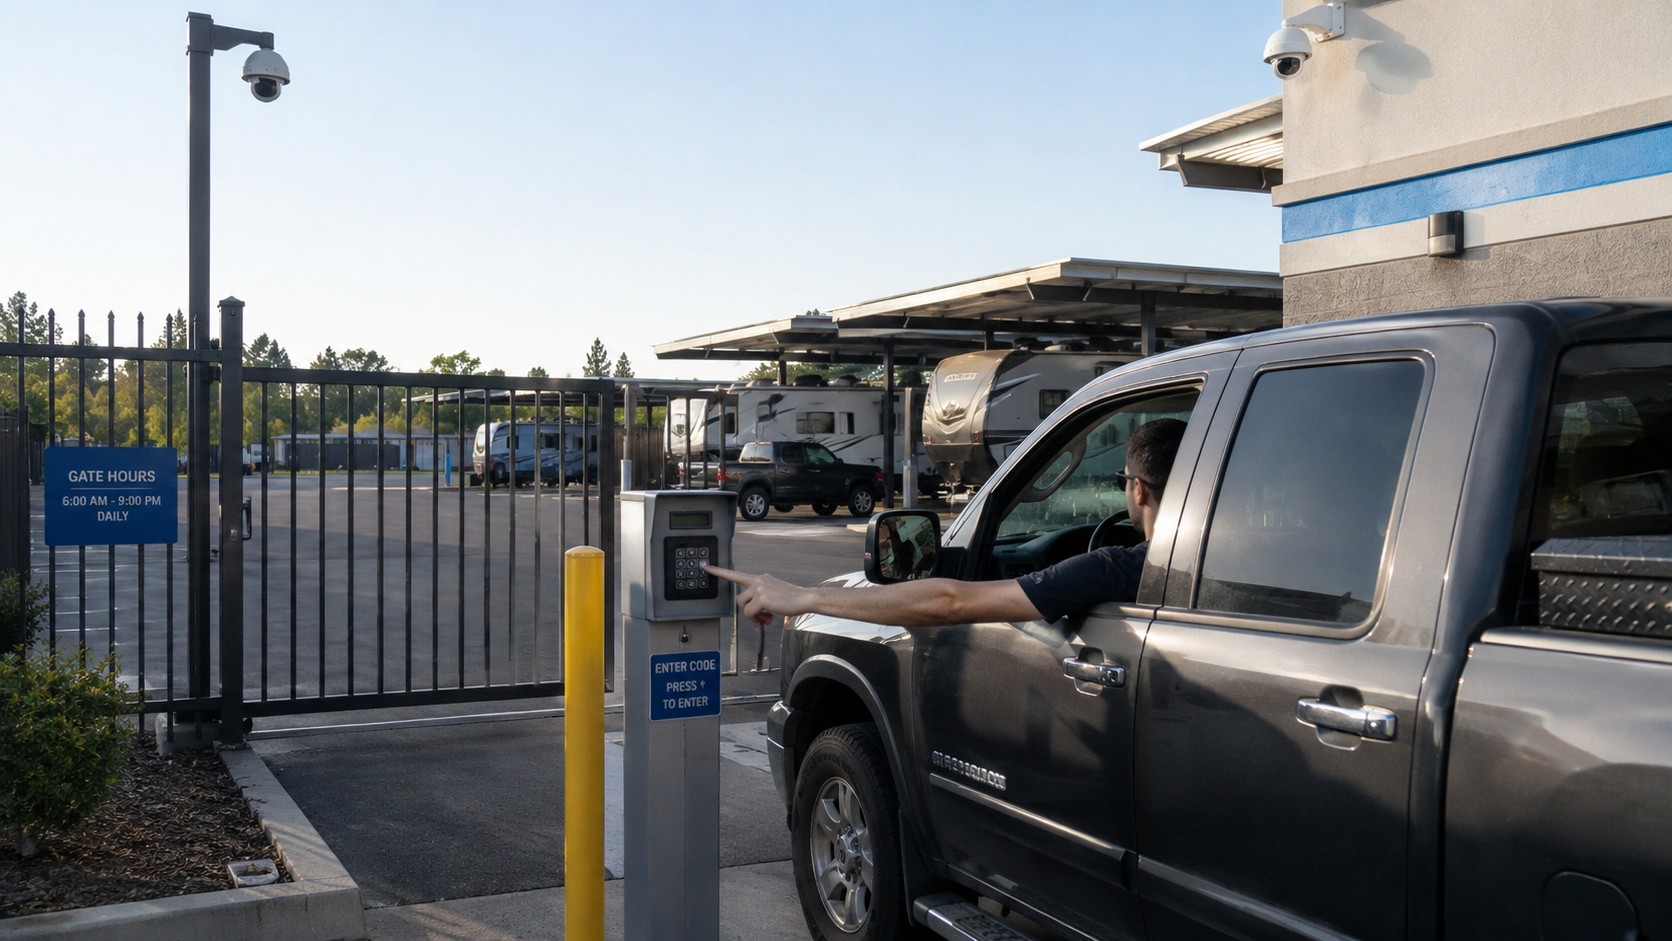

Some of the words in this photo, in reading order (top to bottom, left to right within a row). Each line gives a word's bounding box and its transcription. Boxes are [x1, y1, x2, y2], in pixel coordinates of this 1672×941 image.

[68, 470, 104, 482] GATE
[108, 470, 156, 482] HOURS
[62, 496, 87, 506] 6:00
[89, 496, 108, 506] AM
[118, 496, 142, 506] 9:00
[144, 496, 161, 506] PM
[97, 511, 129, 521] DAILY
[655, 661, 687, 674] ENTER
[690, 659, 716, 671] CODE
[666, 680, 697, 692] PRESS
[662, 699, 676, 709] TO
[678, 696, 709, 708] ENTER
